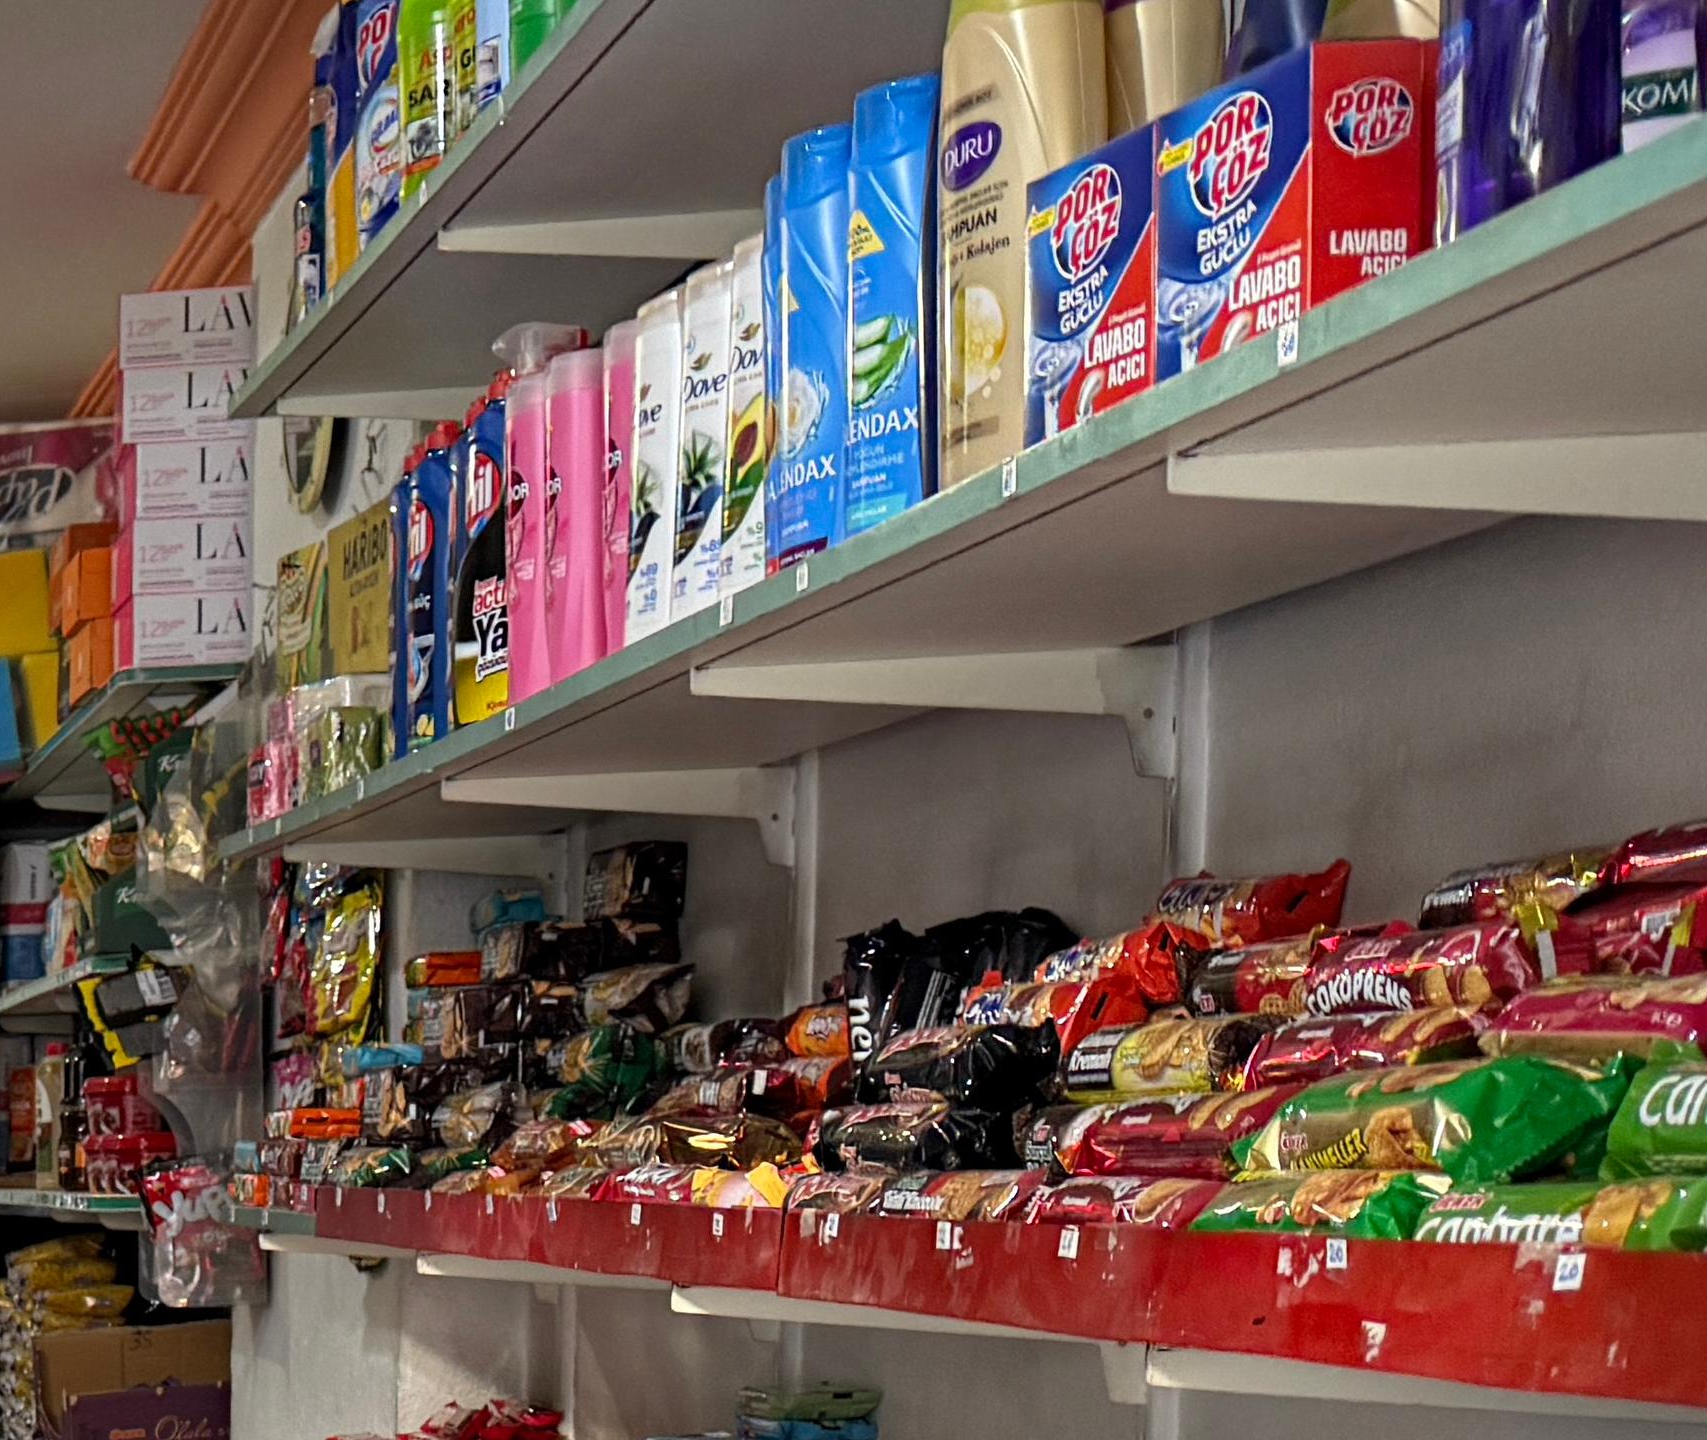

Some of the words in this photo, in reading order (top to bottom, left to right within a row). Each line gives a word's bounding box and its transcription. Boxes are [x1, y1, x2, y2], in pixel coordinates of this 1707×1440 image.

[1330, 83, 1399, 127] POR
[945, 130, 993, 173] DURU
[1191, 94, 1257, 171] POR
[1352, 107, 1412, 155] ÇÖZ
[1211, 129, 1270, 215] ÇÖZ
[1055, 168, 1109, 247] POR
[1197, 200, 1257, 253] EKSTRA
[1071, 203, 1119, 273] ÇÖZ
[1199, 231, 1251, 277] GÜÇLÜ
[1330, 228, 1408, 257] LAVABO
[1058, 265, 1108, 313] EKSTRA
[1230, 254, 1301, 311] LAVABO
[1256, 292, 1300, 332] AÇICI
[731, 343, 764, 375] Dov
[1084, 319, 1146, 367] LAVABO
[1107, 353, 1146, 389] AÇICI
[638, 402, 662, 427] ove
[473, 583, 508, 616] acti
[474, 611, 509, 656] Ya
